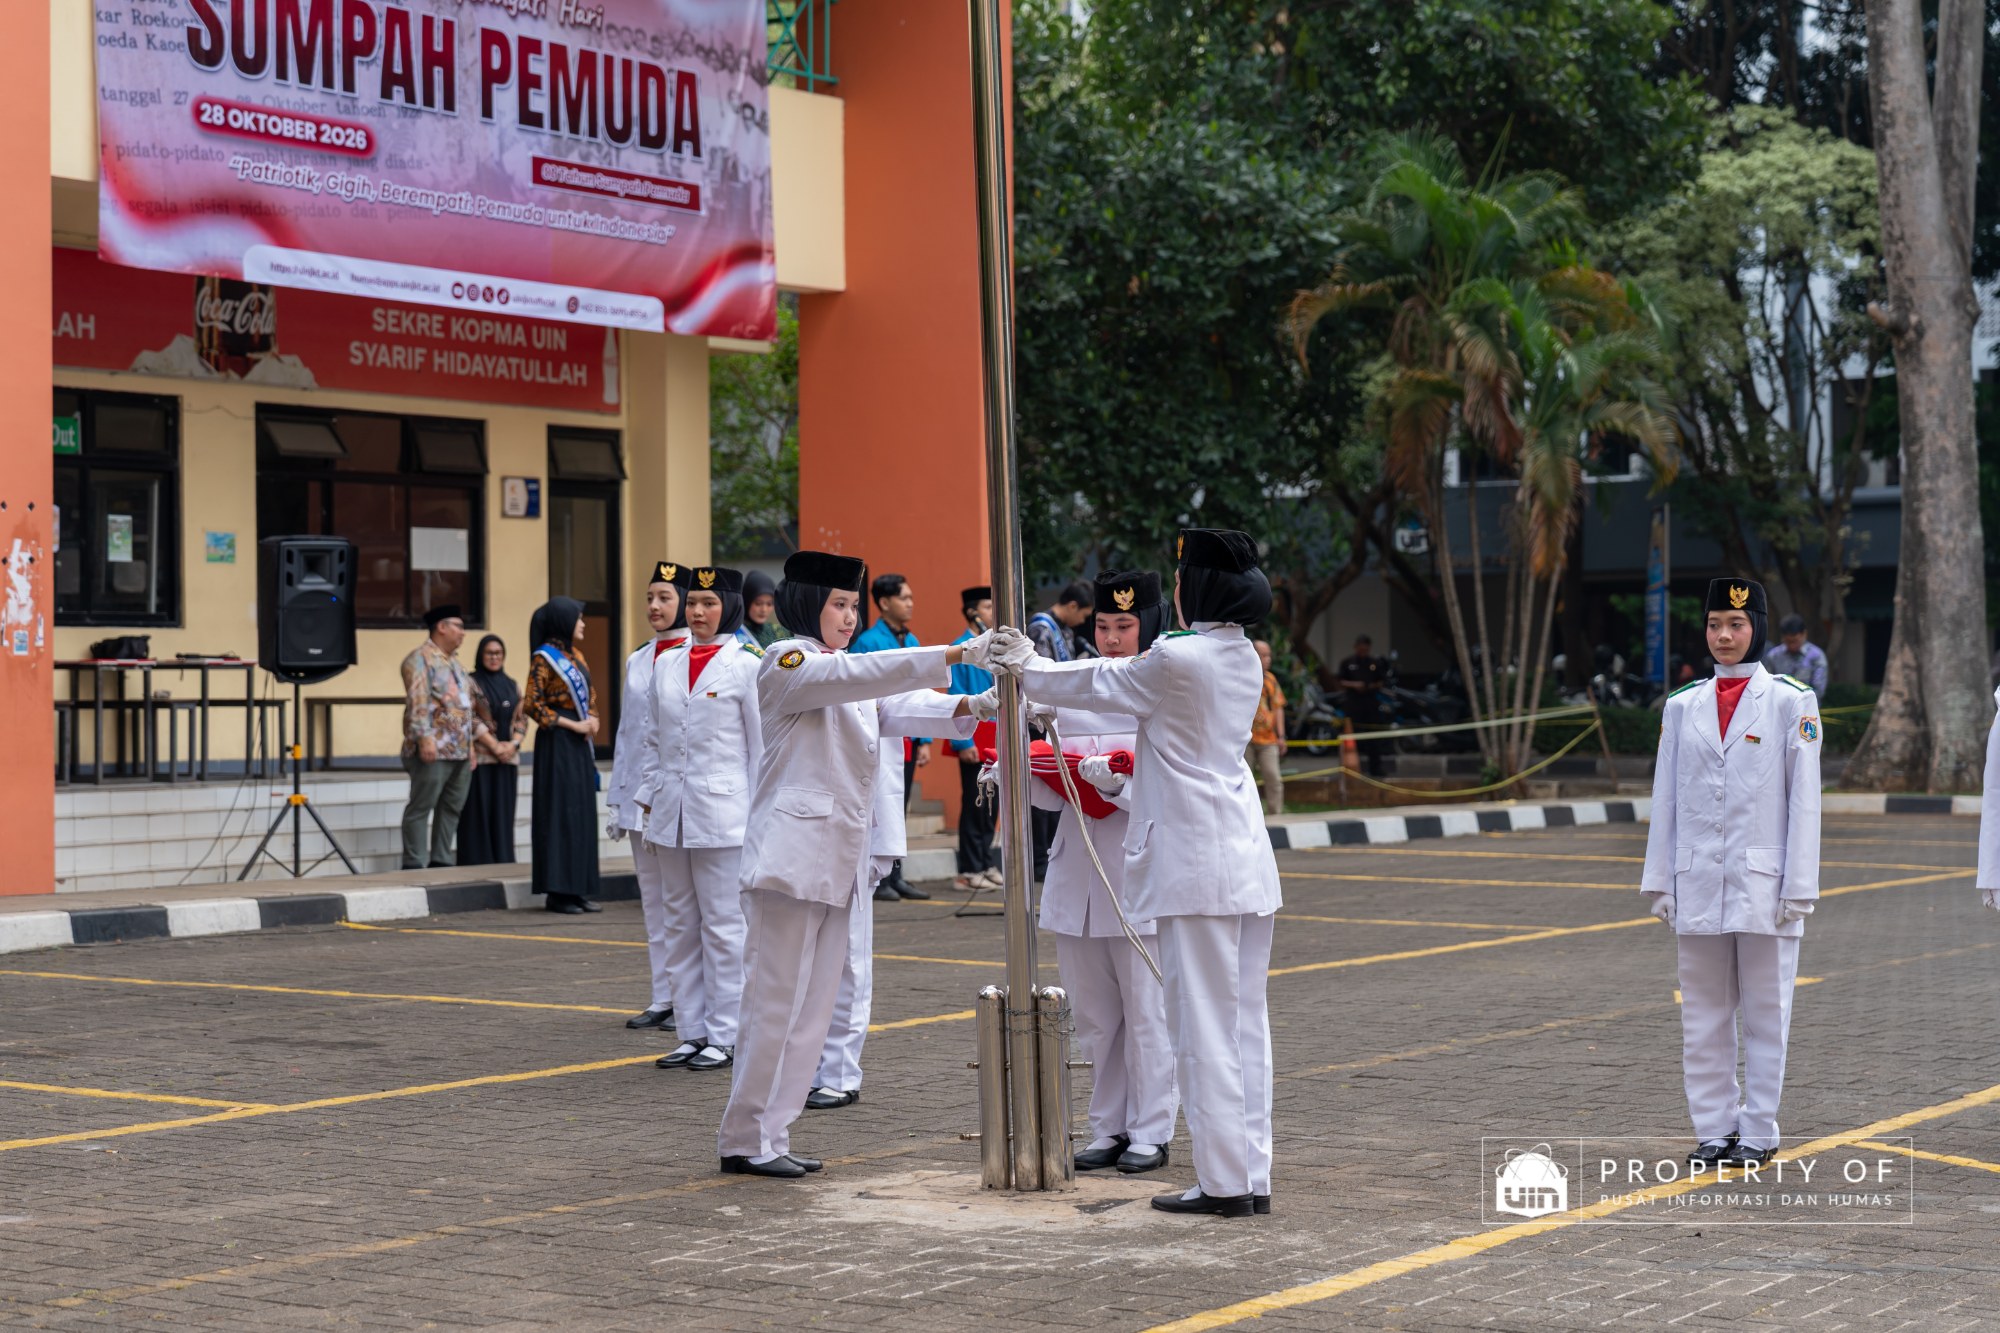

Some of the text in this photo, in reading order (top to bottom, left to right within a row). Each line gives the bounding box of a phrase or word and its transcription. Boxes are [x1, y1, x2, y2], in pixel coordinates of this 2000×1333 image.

[100, 85, 162, 108] tanggal
[185, 0, 457, 116] SUMPAH
[479, 25, 702, 161] PEMUDA
[200, 102, 367, 151] 28 OKTOBER 2026
[326, 174, 377, 201] Gigih,
[475, 194, 544, 226] Pemuda
[52, 311, 96, 340] AH
[372, 307, 567, 351] SEKRE KOPMA UIN
[350, 341, 588, 387] SYARIF HIDAYATULLAH
